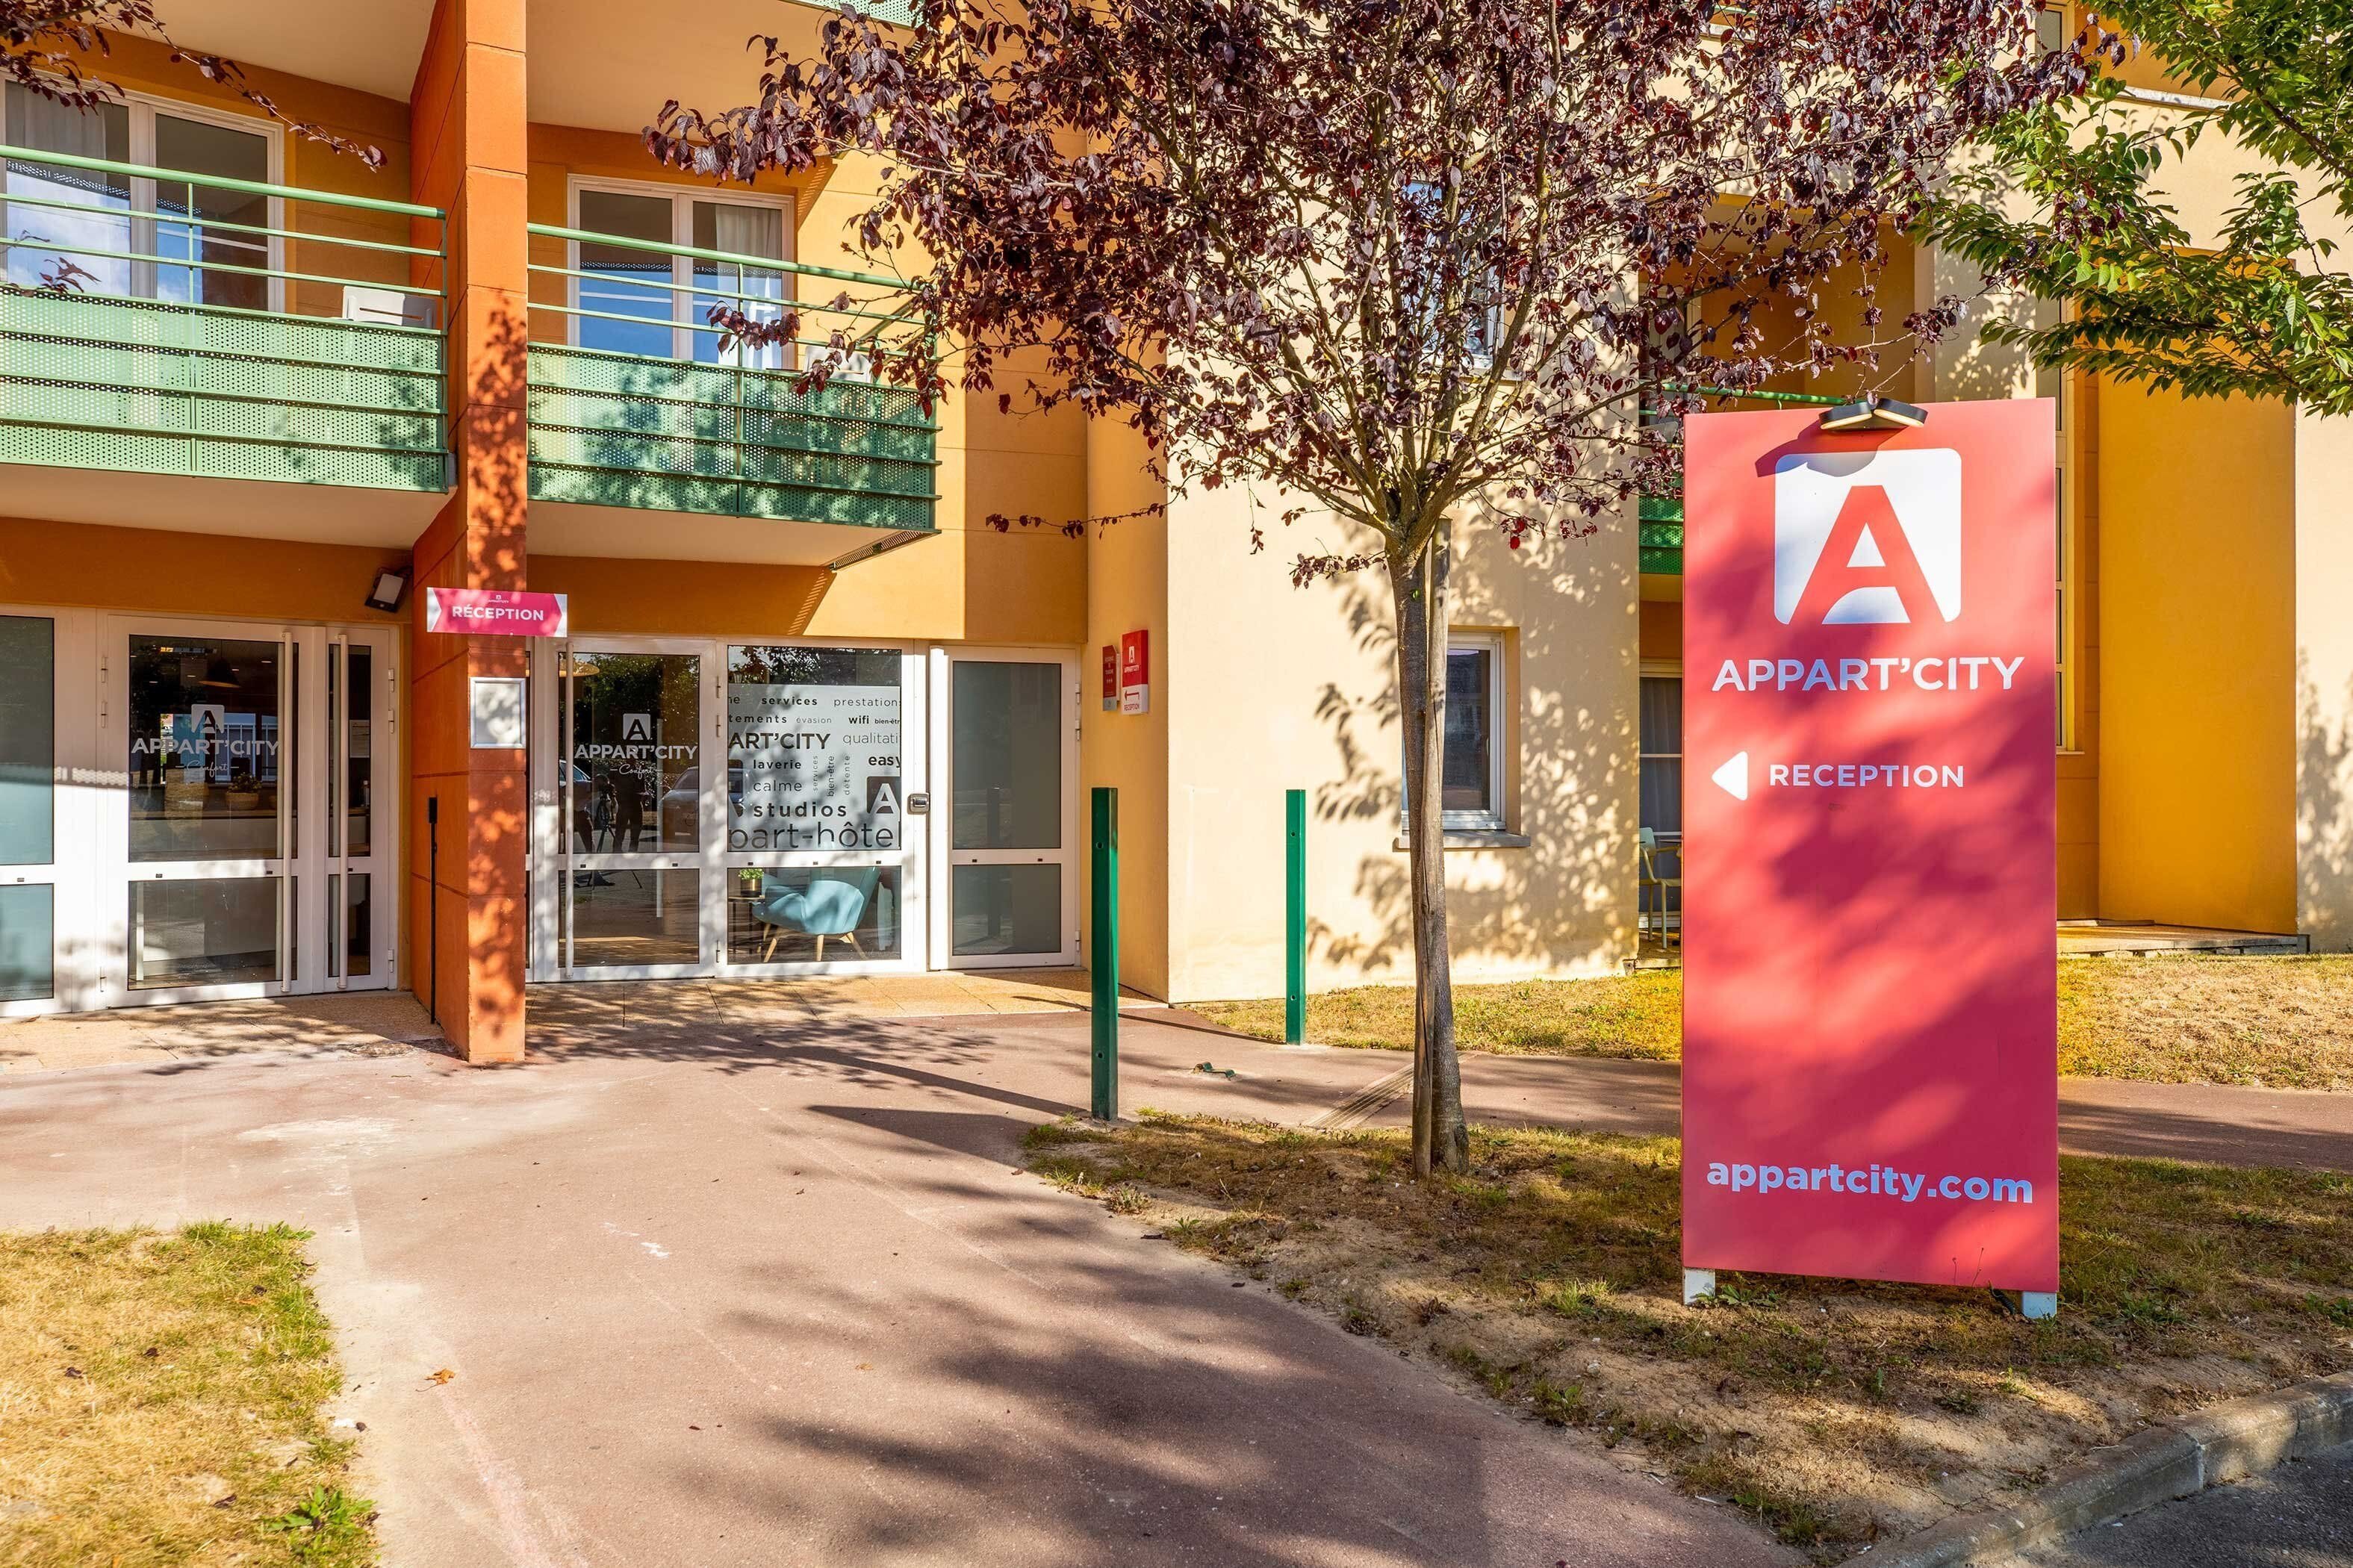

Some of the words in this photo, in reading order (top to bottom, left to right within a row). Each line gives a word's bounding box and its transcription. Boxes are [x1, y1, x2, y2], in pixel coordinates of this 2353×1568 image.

[1788, 485, 1947, 625] A
[452, 604, 544, 621] RÉCEPTION
[761, 695, 818, 706] services
[729, 714, 788, 724] tements
[796, 716, 833, 724] évasion
[848, 715, 869, 724] wifi
[753, 759, 802, 769] laverie
[827, 755, 835, 797] bien-être
[1769, 764, 1965, 788] RECEPTION
[753, 780, 803, 791] calme
[753, 801, 848, 818] studios
[1706, 1162, 2034, 1204] appartcity.com
